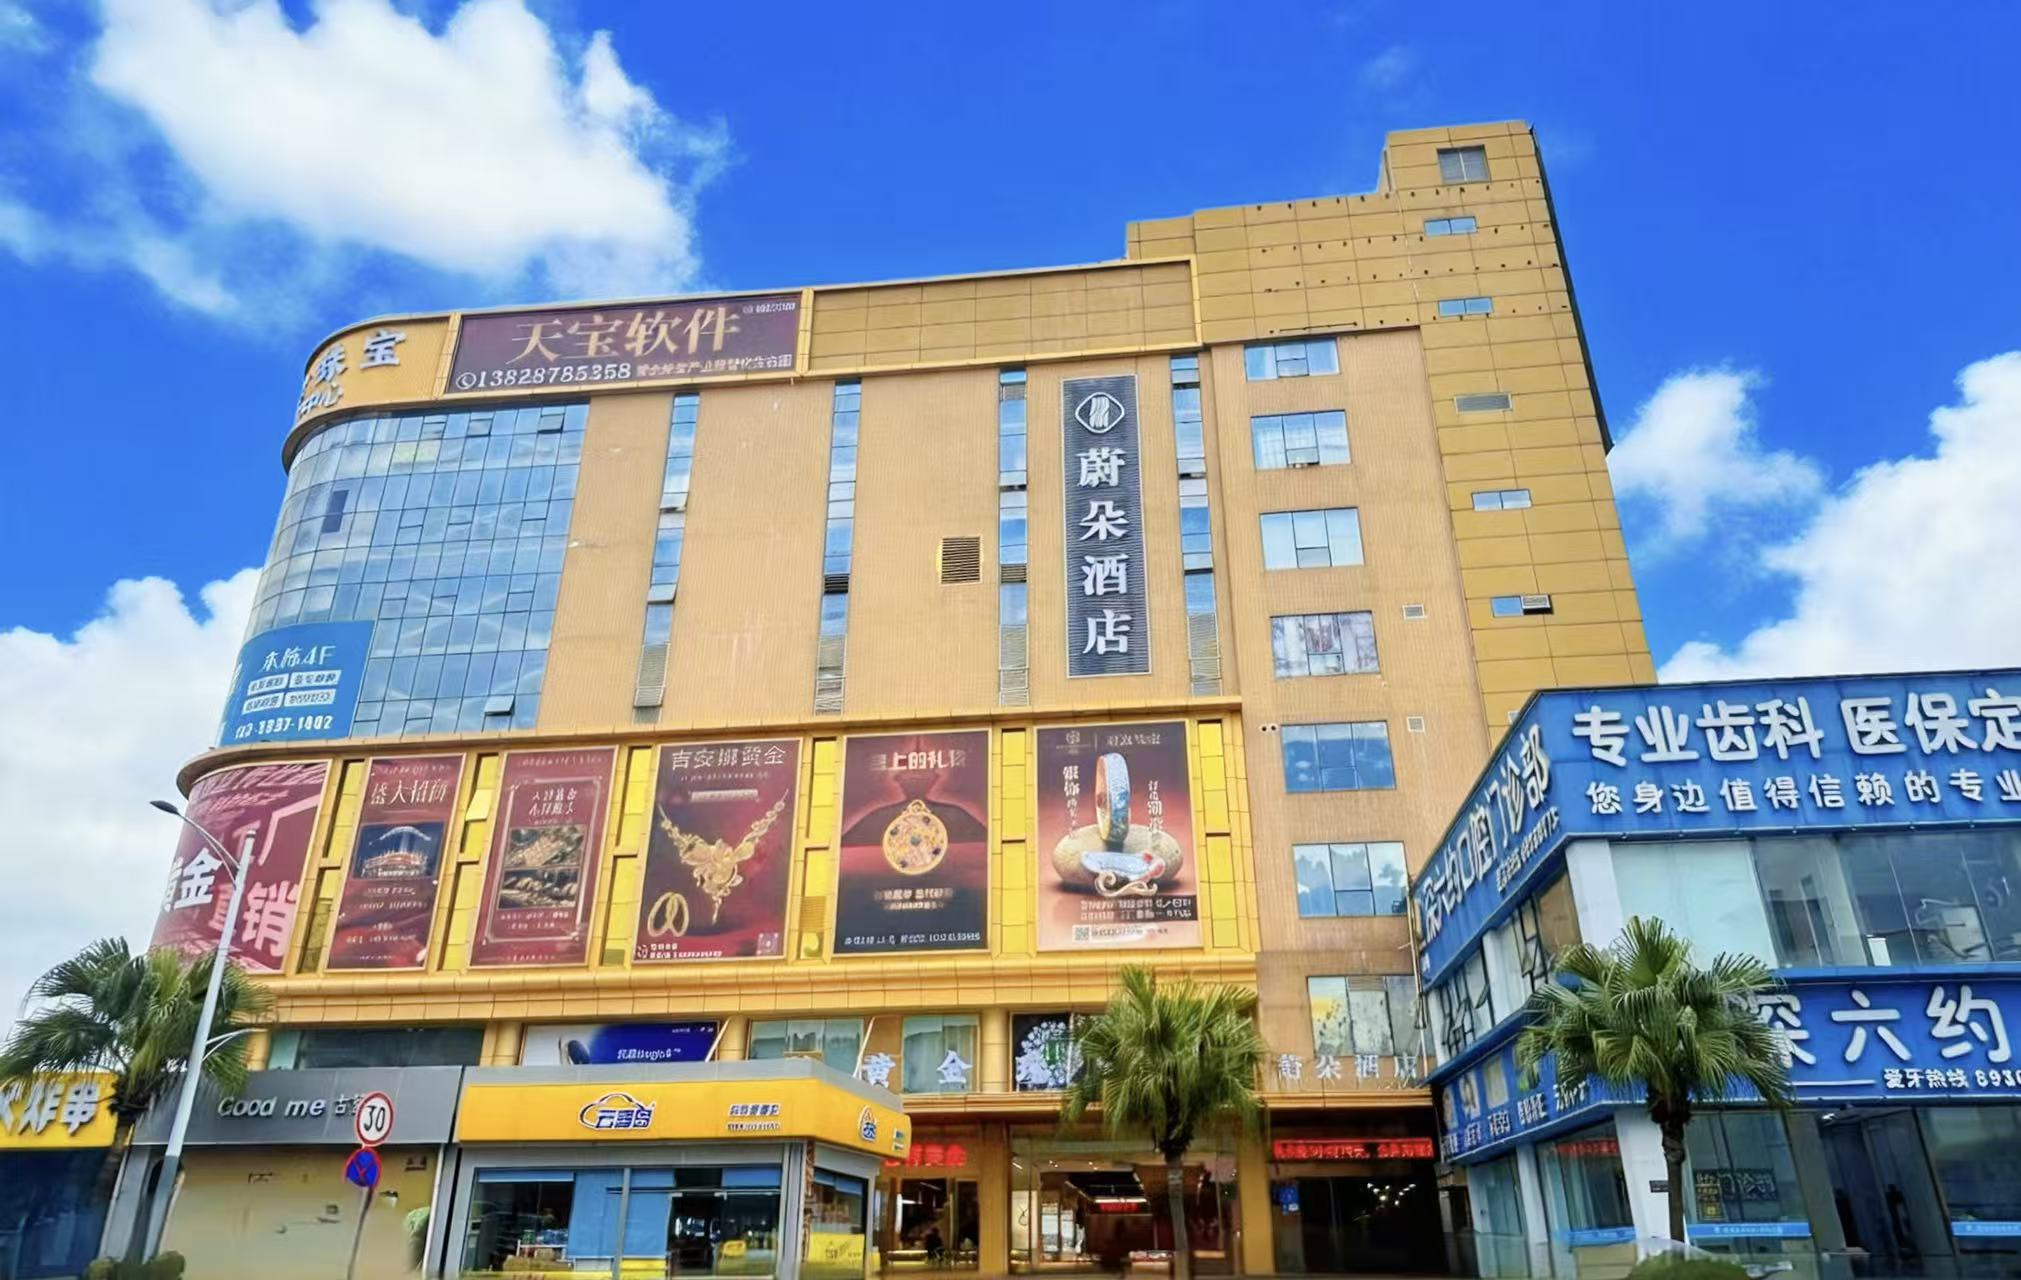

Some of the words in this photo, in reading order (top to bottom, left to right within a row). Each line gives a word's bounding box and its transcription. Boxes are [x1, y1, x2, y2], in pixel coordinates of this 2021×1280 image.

[505, 306, 741, 366] 天宝软件
[1076, 446, 1133, 656] 蔚朵酒店
[1572, 696, 1825, 768] 专业齿科
[1841, 688, 2021, 755] 医保定
[1586, 767, 2021, 815] 您身边值得信赖的专业
[1883, 1067, 1969, 1089] 爱牙热线
[216, 1095, 278, 1118] Good
[283, 1099, 326, 1117] me
[363, 1105, 386, 1133] 30
